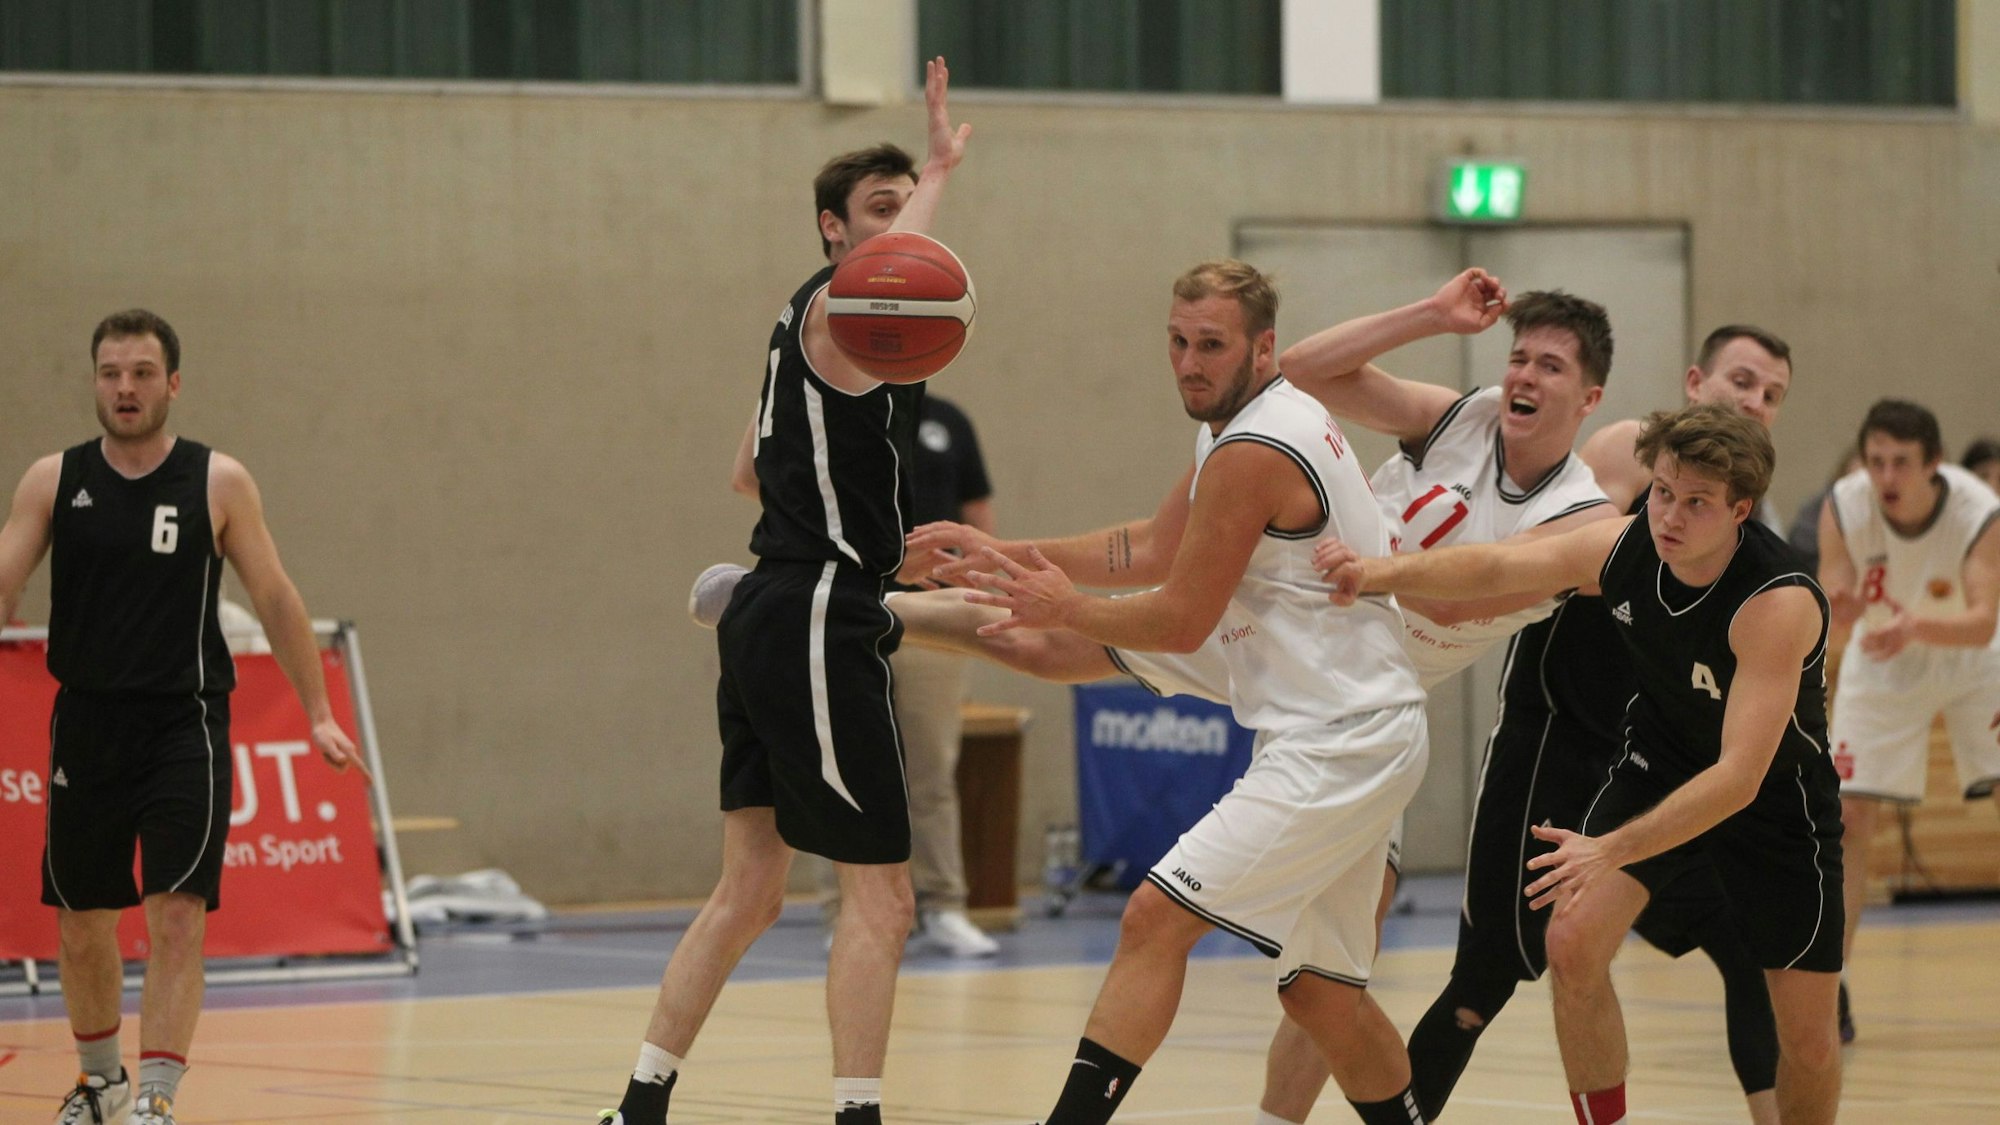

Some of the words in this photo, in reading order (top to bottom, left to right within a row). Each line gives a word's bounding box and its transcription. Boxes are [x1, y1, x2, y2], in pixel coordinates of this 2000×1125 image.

[151, 505, 178, 554] 6
[1402, 485, 1469, 551] 11
[1861, 565, 1885, 603] 8
[1692, 661, 1722, 700] 4
[1092, 708, 1228, 755] molten
[0, 769, 42, 804] se
[223, 842, 257, 867] en
[260, 833, 343, 872] Sport
[1172, 867, 1202, 892] JAKO
